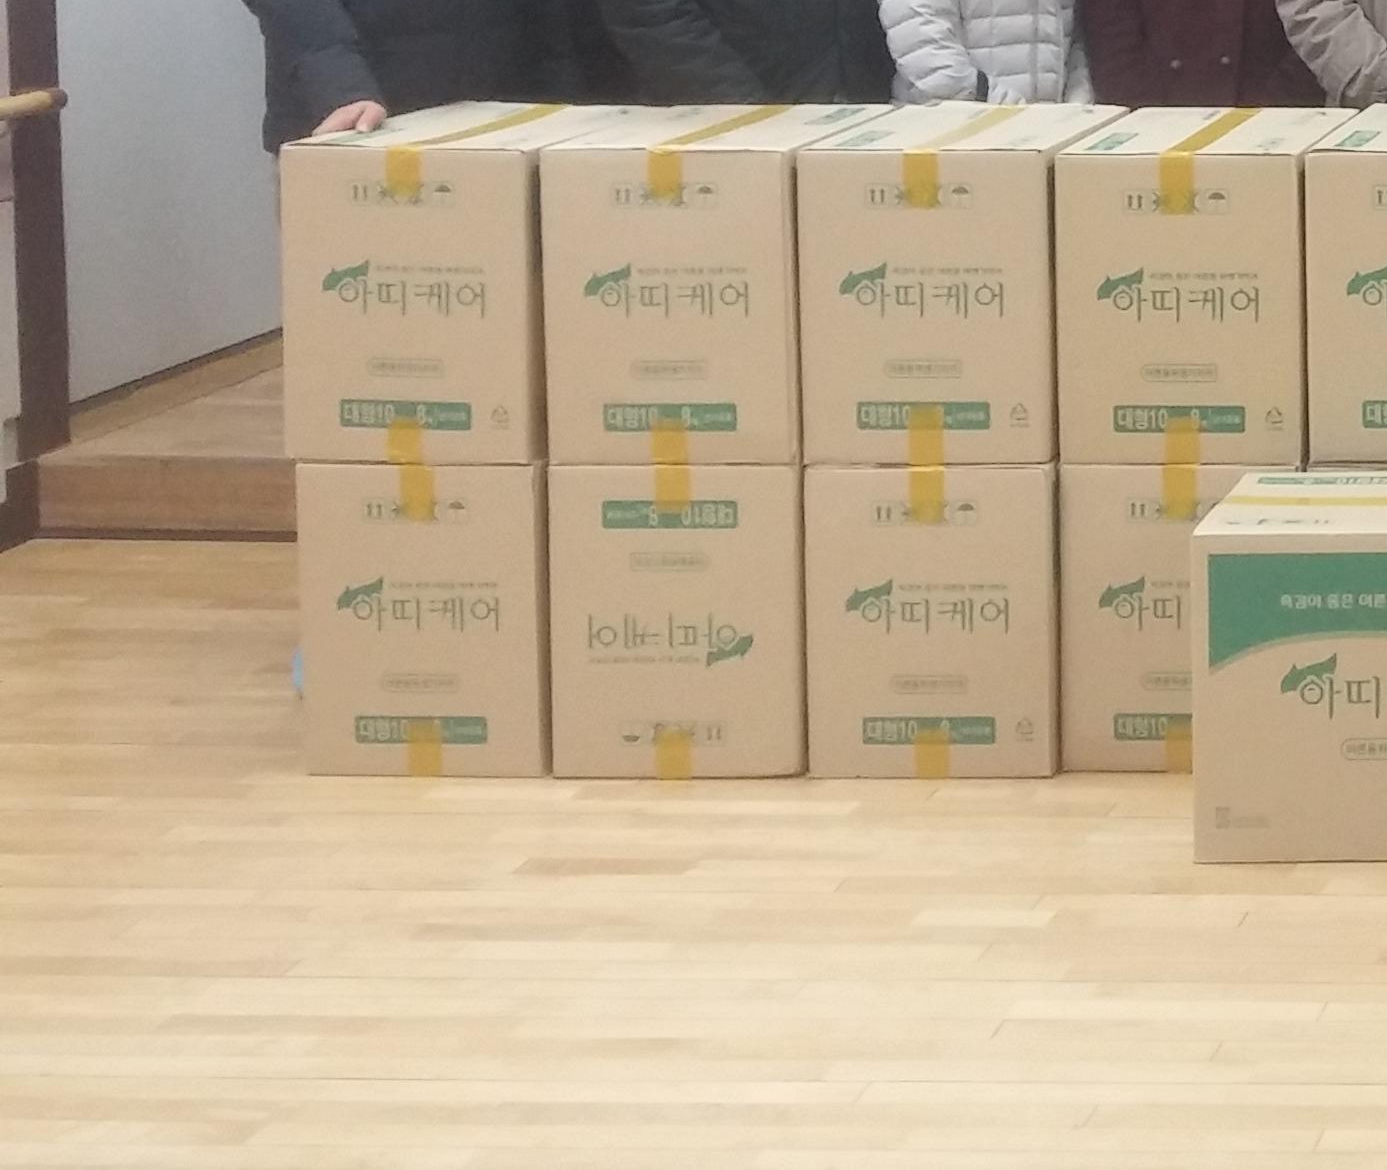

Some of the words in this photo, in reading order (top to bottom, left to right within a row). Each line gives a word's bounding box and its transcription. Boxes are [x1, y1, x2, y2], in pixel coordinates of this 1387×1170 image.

[338, 280, 487, 317] 아띠케어
[600, 281, 750, 318] 아띠케어
[855, 282, 1005, 319] 아띠케어
[1113, 285, 1261, 322] 아띠케어
[352, 596, 500, 632] 아띠케어
[862, 597, 1010, 634] 아띠케어
[1114, 595, 1181, 630] 아띠
